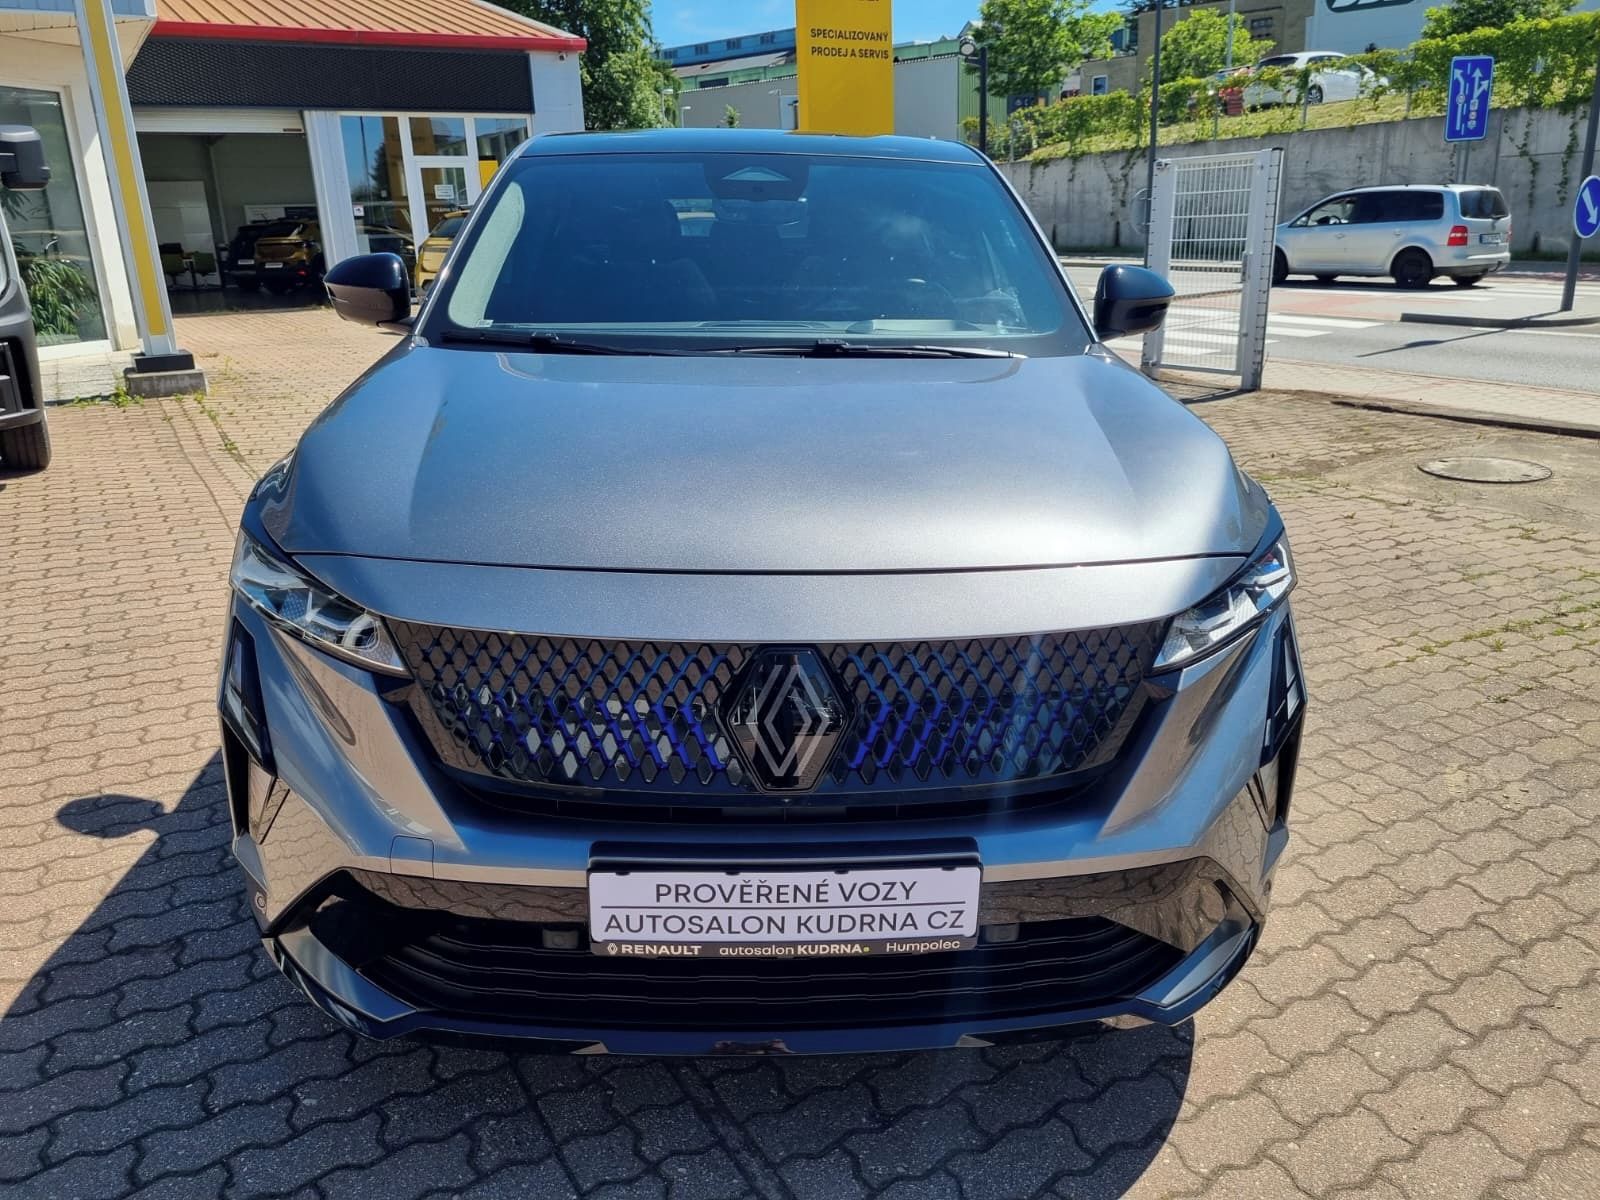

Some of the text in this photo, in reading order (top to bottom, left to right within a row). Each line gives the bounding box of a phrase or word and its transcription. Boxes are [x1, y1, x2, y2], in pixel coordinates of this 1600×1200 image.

[811, 46, 889, 60] PRODEJ A SERVIS
[655, 879, 918, 904] PROVĚŘENÉ VOZY
[604, 909, 965, 935] AUTOSALON KUDRNA CZ
[621, 943, 702, 956] RENAULT
[719, 944, 794, 957] autosalon
[886, 939, 961, 953] Humpolec
